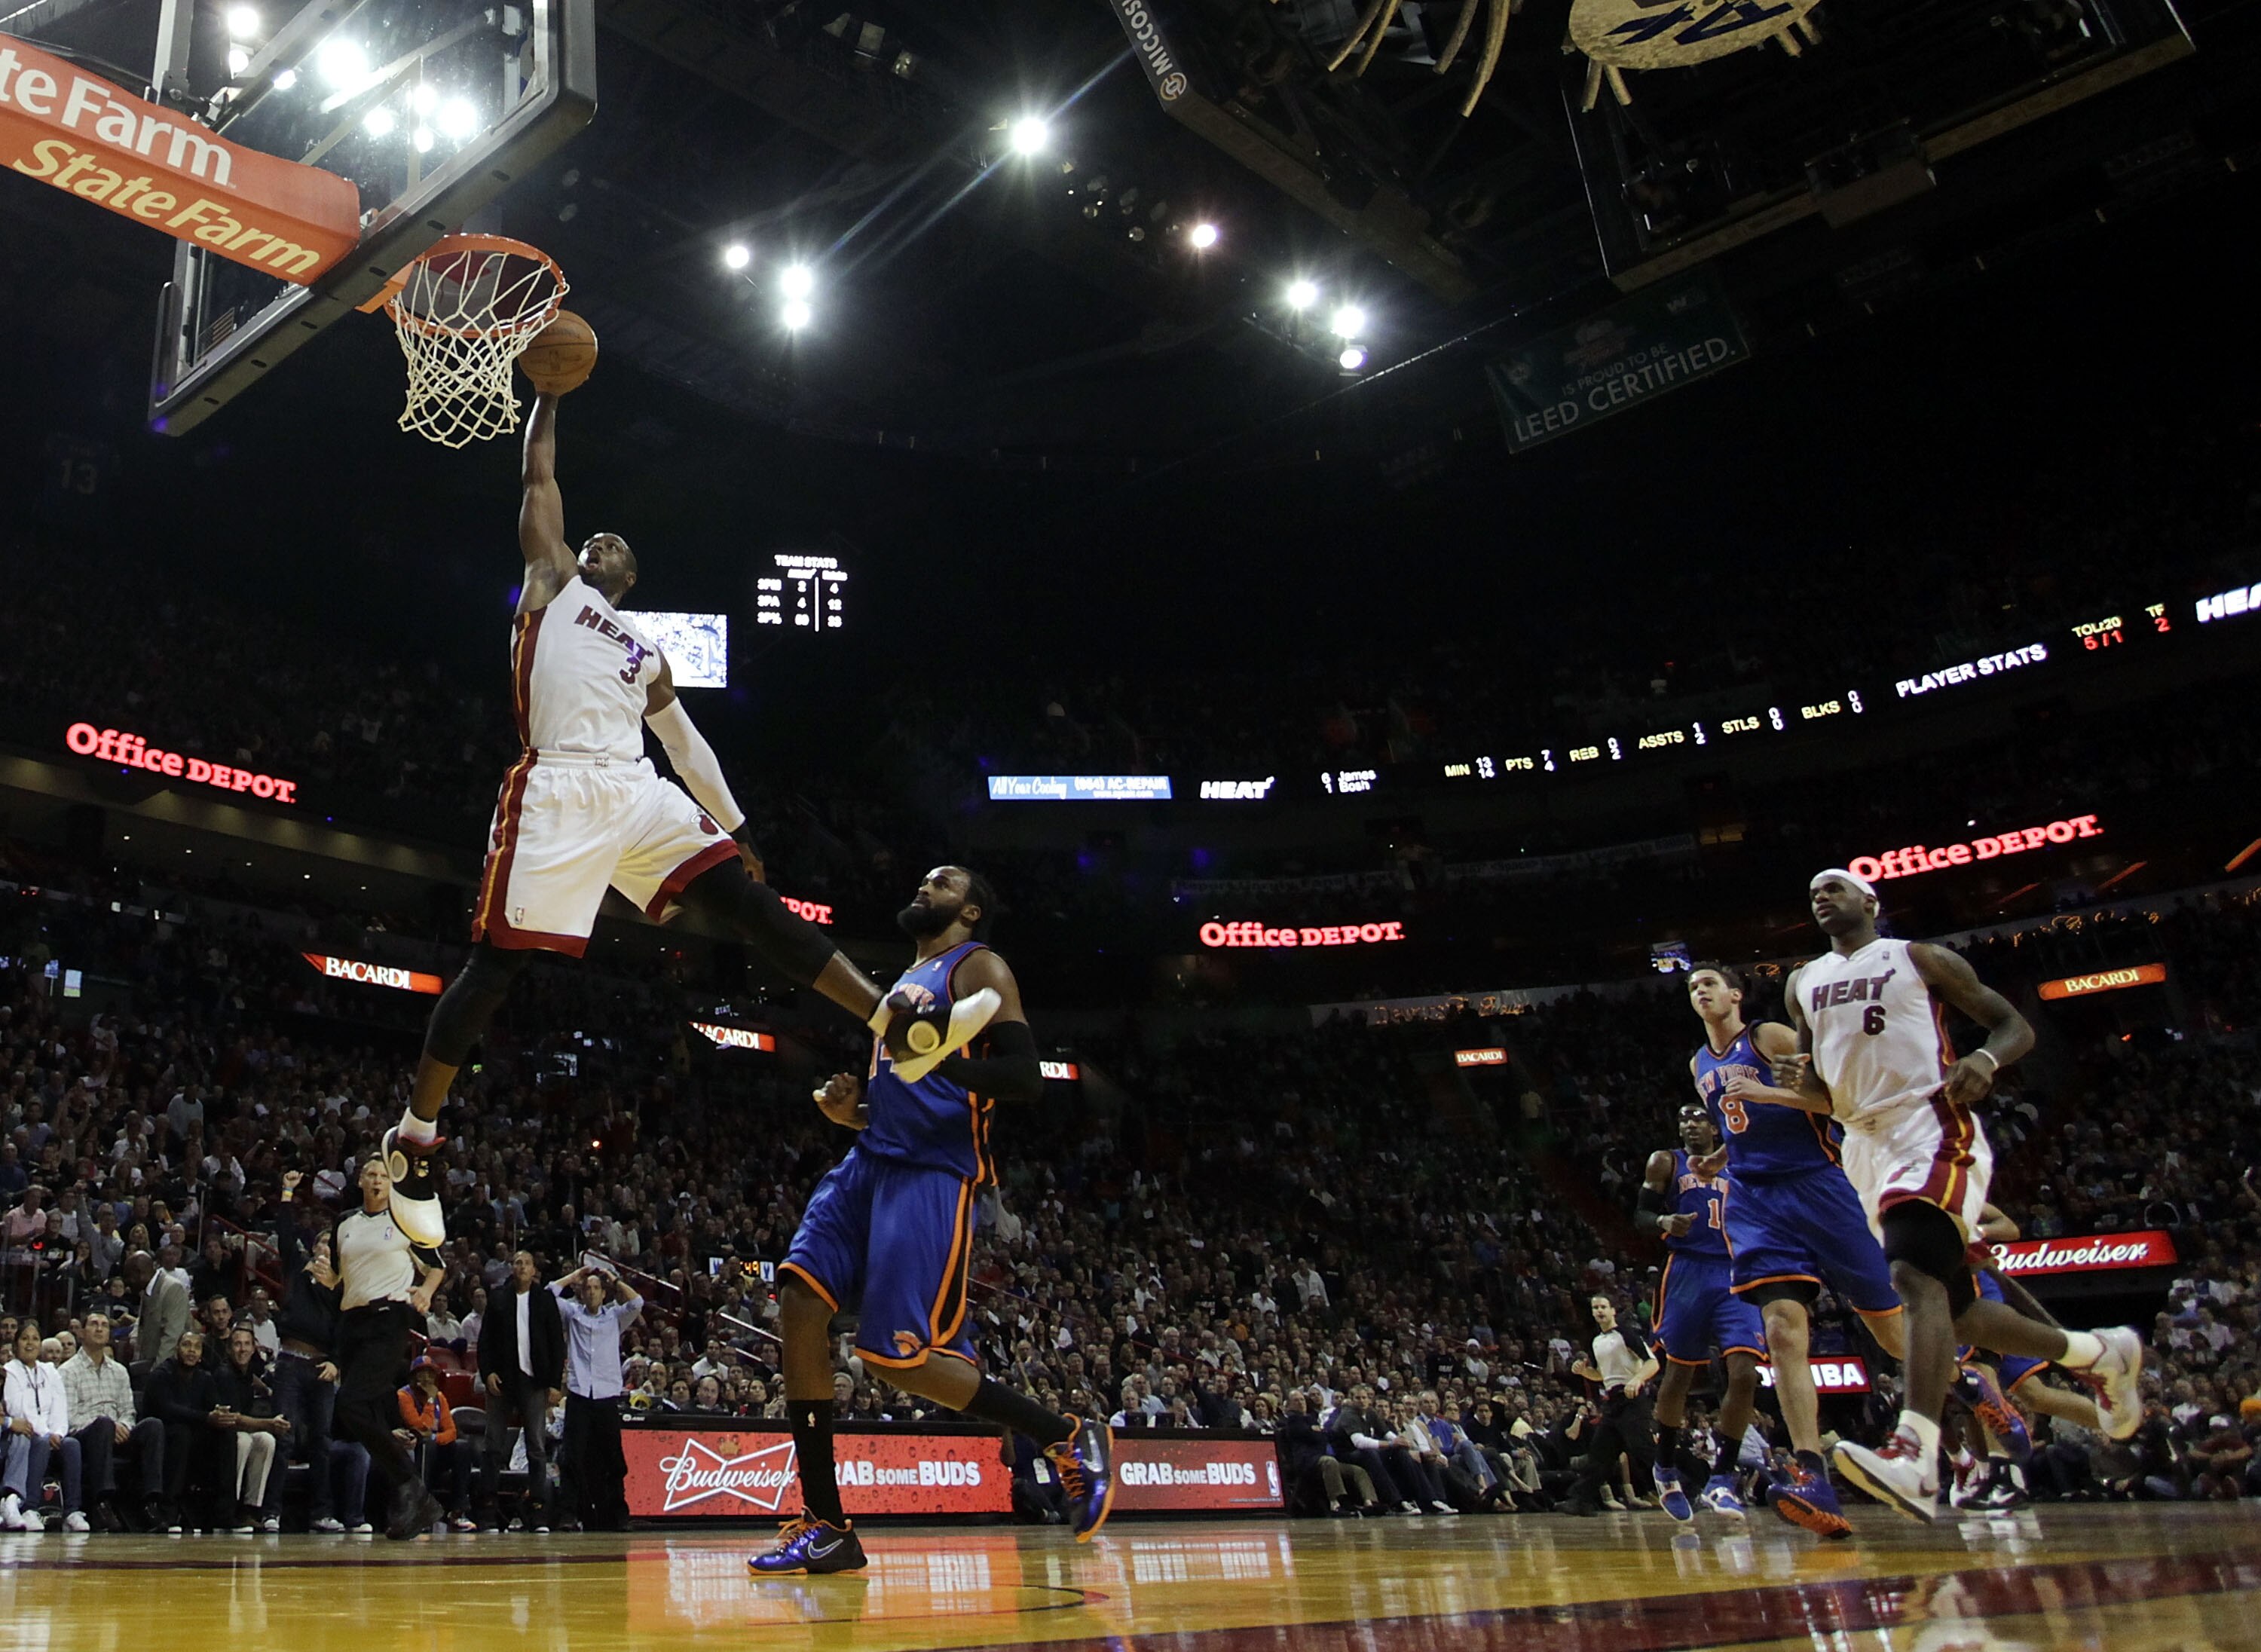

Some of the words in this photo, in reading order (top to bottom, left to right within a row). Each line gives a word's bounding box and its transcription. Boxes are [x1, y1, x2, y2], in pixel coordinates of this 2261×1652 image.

[60, 75, 233, 185] Farm
[12, 139, 177, 219] State
[165, 198, 320, 276] Farm
[1562, 383, 1574, 397] IS
[1577, 359, 1625, 393] PROUD
[1626, 350, 1648, 371] TO
[1649, 342, 1668, 365] BE
[1513, 399, 1580, 443] LEED
[1587, 335, 1736, 412] CERTIFIED.
[2145, 604, 2165, 618] TF
[574, 604, 653, 662] HEAT
[2154, 617, 2171, 632] 2
[619, 656, 641, 684] 3
[1895, 662, 1977, 698] PLAYER
[1977, 642, 2048, 675] STATS
[1848, 690, 1859, 702] 0
[1768, 707, 1779, 719] 0
[1801, 700, 1840, 719] BLKS
[1852, 702, 1862, 713] 0
[1722, 716, 1760, 734] STLS
[1772, 718, 1783, 730] 0
[66, 721, 185, 776] Office
[1608, 737, 1618, 749] 0
[1638, 730, 1684, 749] ASSTS
[1695, 733, 1706, 745] 2
[1476, 756, 1492, 769] 13
[1541, 749, 1550, 761] 7
[1569, 746, 1599, 762] REB
[1611, 748, 1620, 760] 2
[1445, 763, 1470, 777] MIN
[1478, 767, 1495, 779] 14
[1505, 757, 1533, 771] PTS
[1544, 760, 1554, 772] 4
[1321, 772, 1331, 784] 6
[1338, 769, 1376, 783] James
[1200, 776, 1274, 799] HEAT
[1339, 781, 1370, 793] Bosh
[1849, 845, 1973, 883] Office
[1200, 922, 1298, 947] Office
[325, 956, 412, 990] BACARDI
[2064, 969, 2140, 993] BACARDI
[1812, 968, 1896, 1013] HEAT
[1862, 1005, 1885, 1036] 6
[1456, 1051, 1504, 1063] BACARDI
[1718, 1094, 1749, 1135] 8
[1707, 1198, 1721, 1230] 1
[1990, 1238, 2149, 1271] Budweiser
[659, 1455, 796, 1492] Budweiser
[919, 1461, 981, 1486] BUDS
[1120, 1462, 1173, 1485] GRAB
[1206, 1462, 1256, 1485] BUDS
